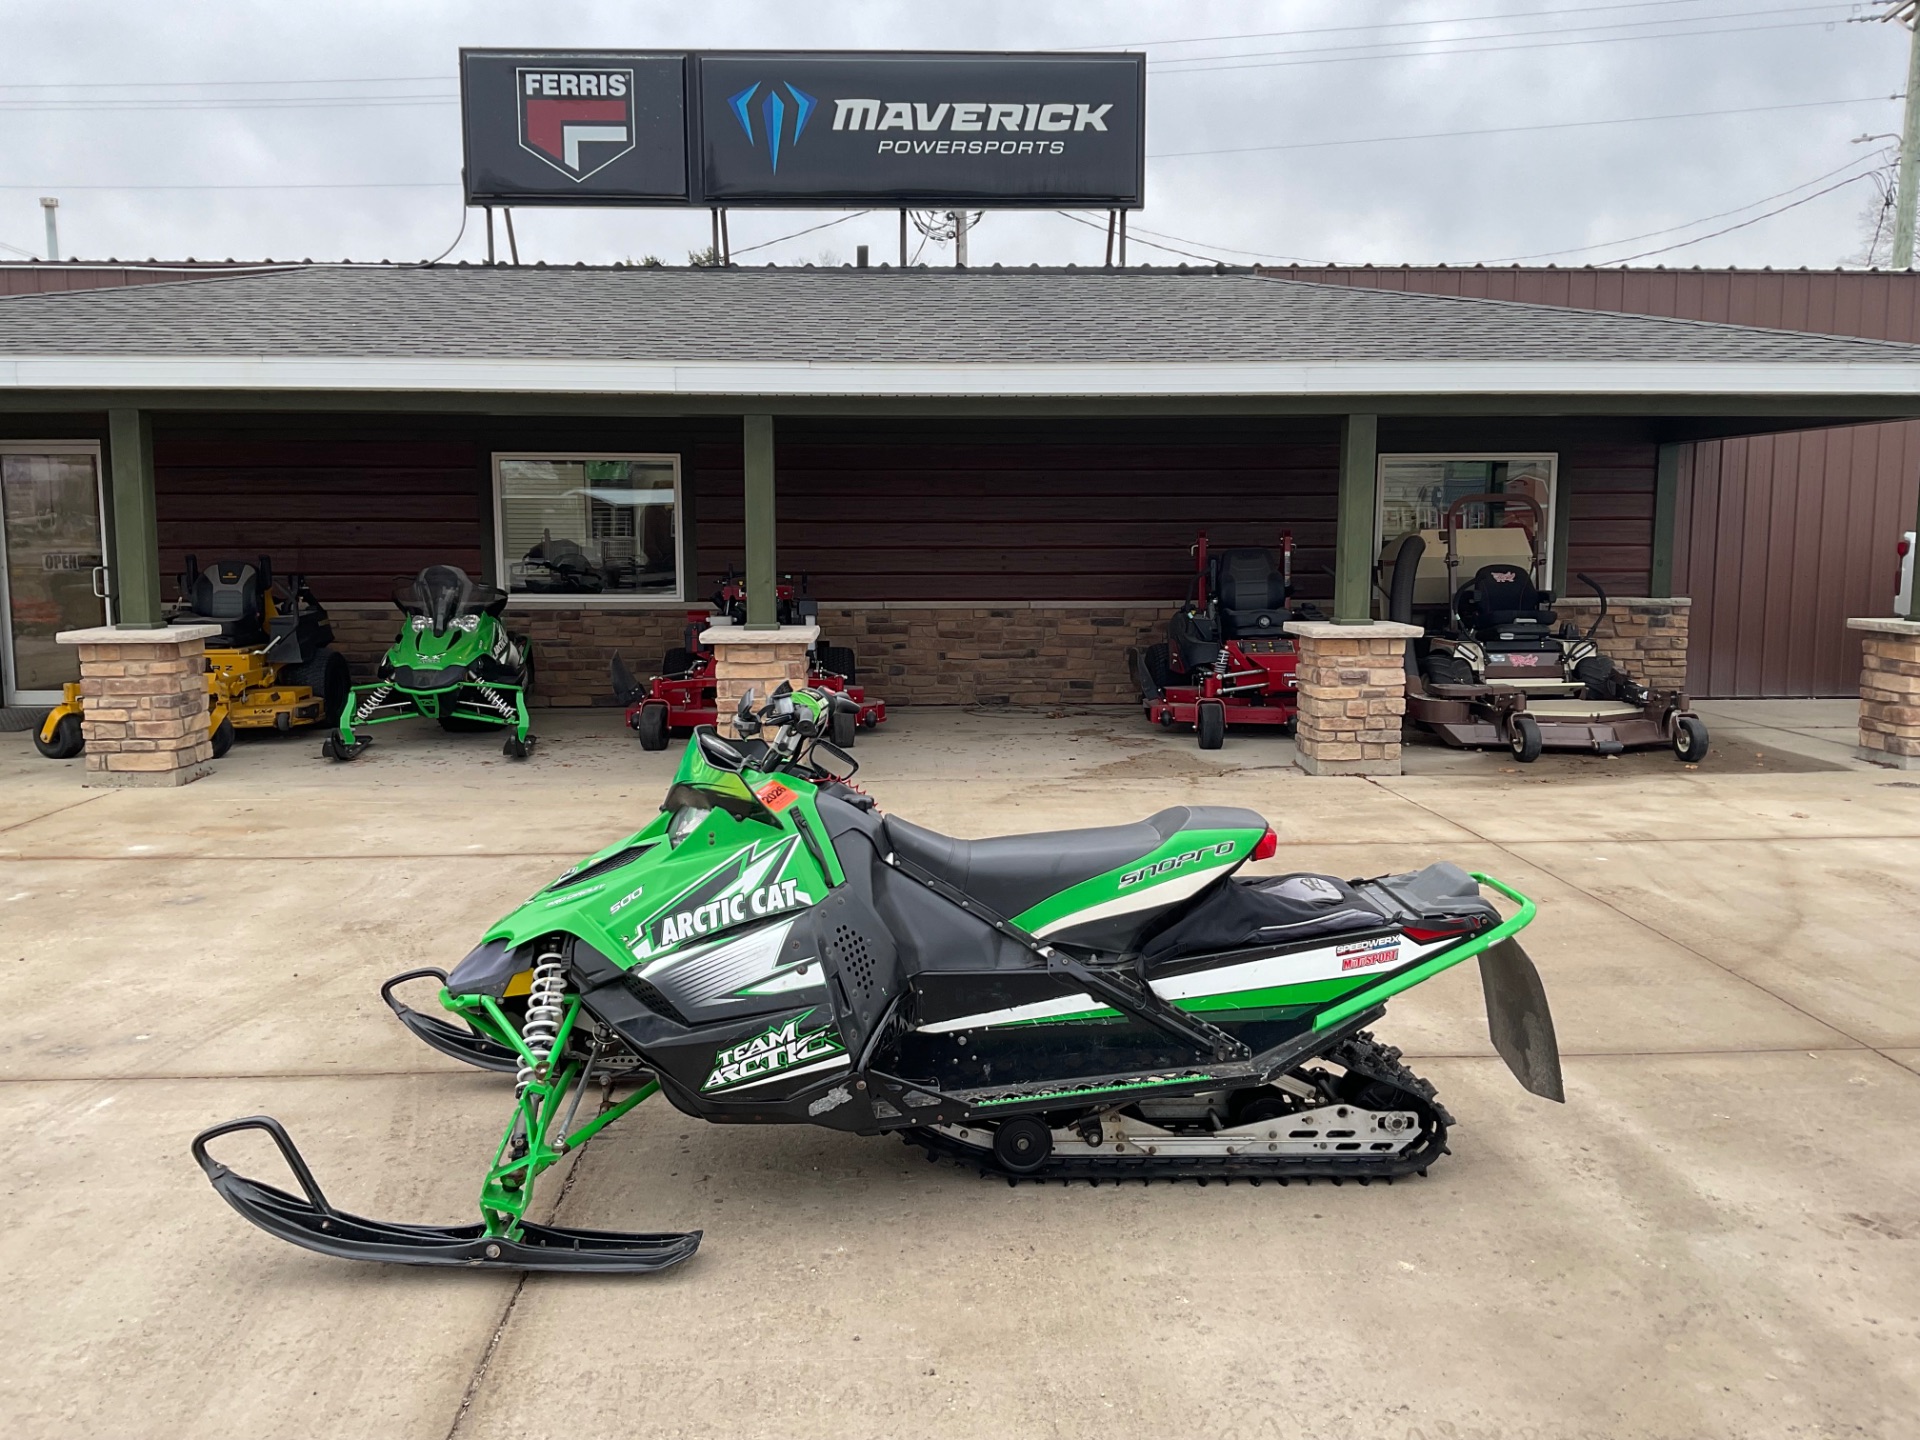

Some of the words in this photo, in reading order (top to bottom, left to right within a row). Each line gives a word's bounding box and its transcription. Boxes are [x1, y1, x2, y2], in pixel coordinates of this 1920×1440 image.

[525, 73, 627, 97] FERRIS
[832, 98, 1114, 132] MAVERICK
[877, 140, 1065, 155] POWERSPORTS
[45, 554, 77, 570] OPEN
[761, 785, 787, 805] 2026
[610, 885, 644, 916] 500
[660, 892, 746, 947] ARCTIC
[751, 878, 798, 915] CAT
[1336, 934, 1402, 955] SPEEDWERX
[718, 1020, 797, 1067] TEAM
[704, 1030, 836, 1089] ARCTIC
